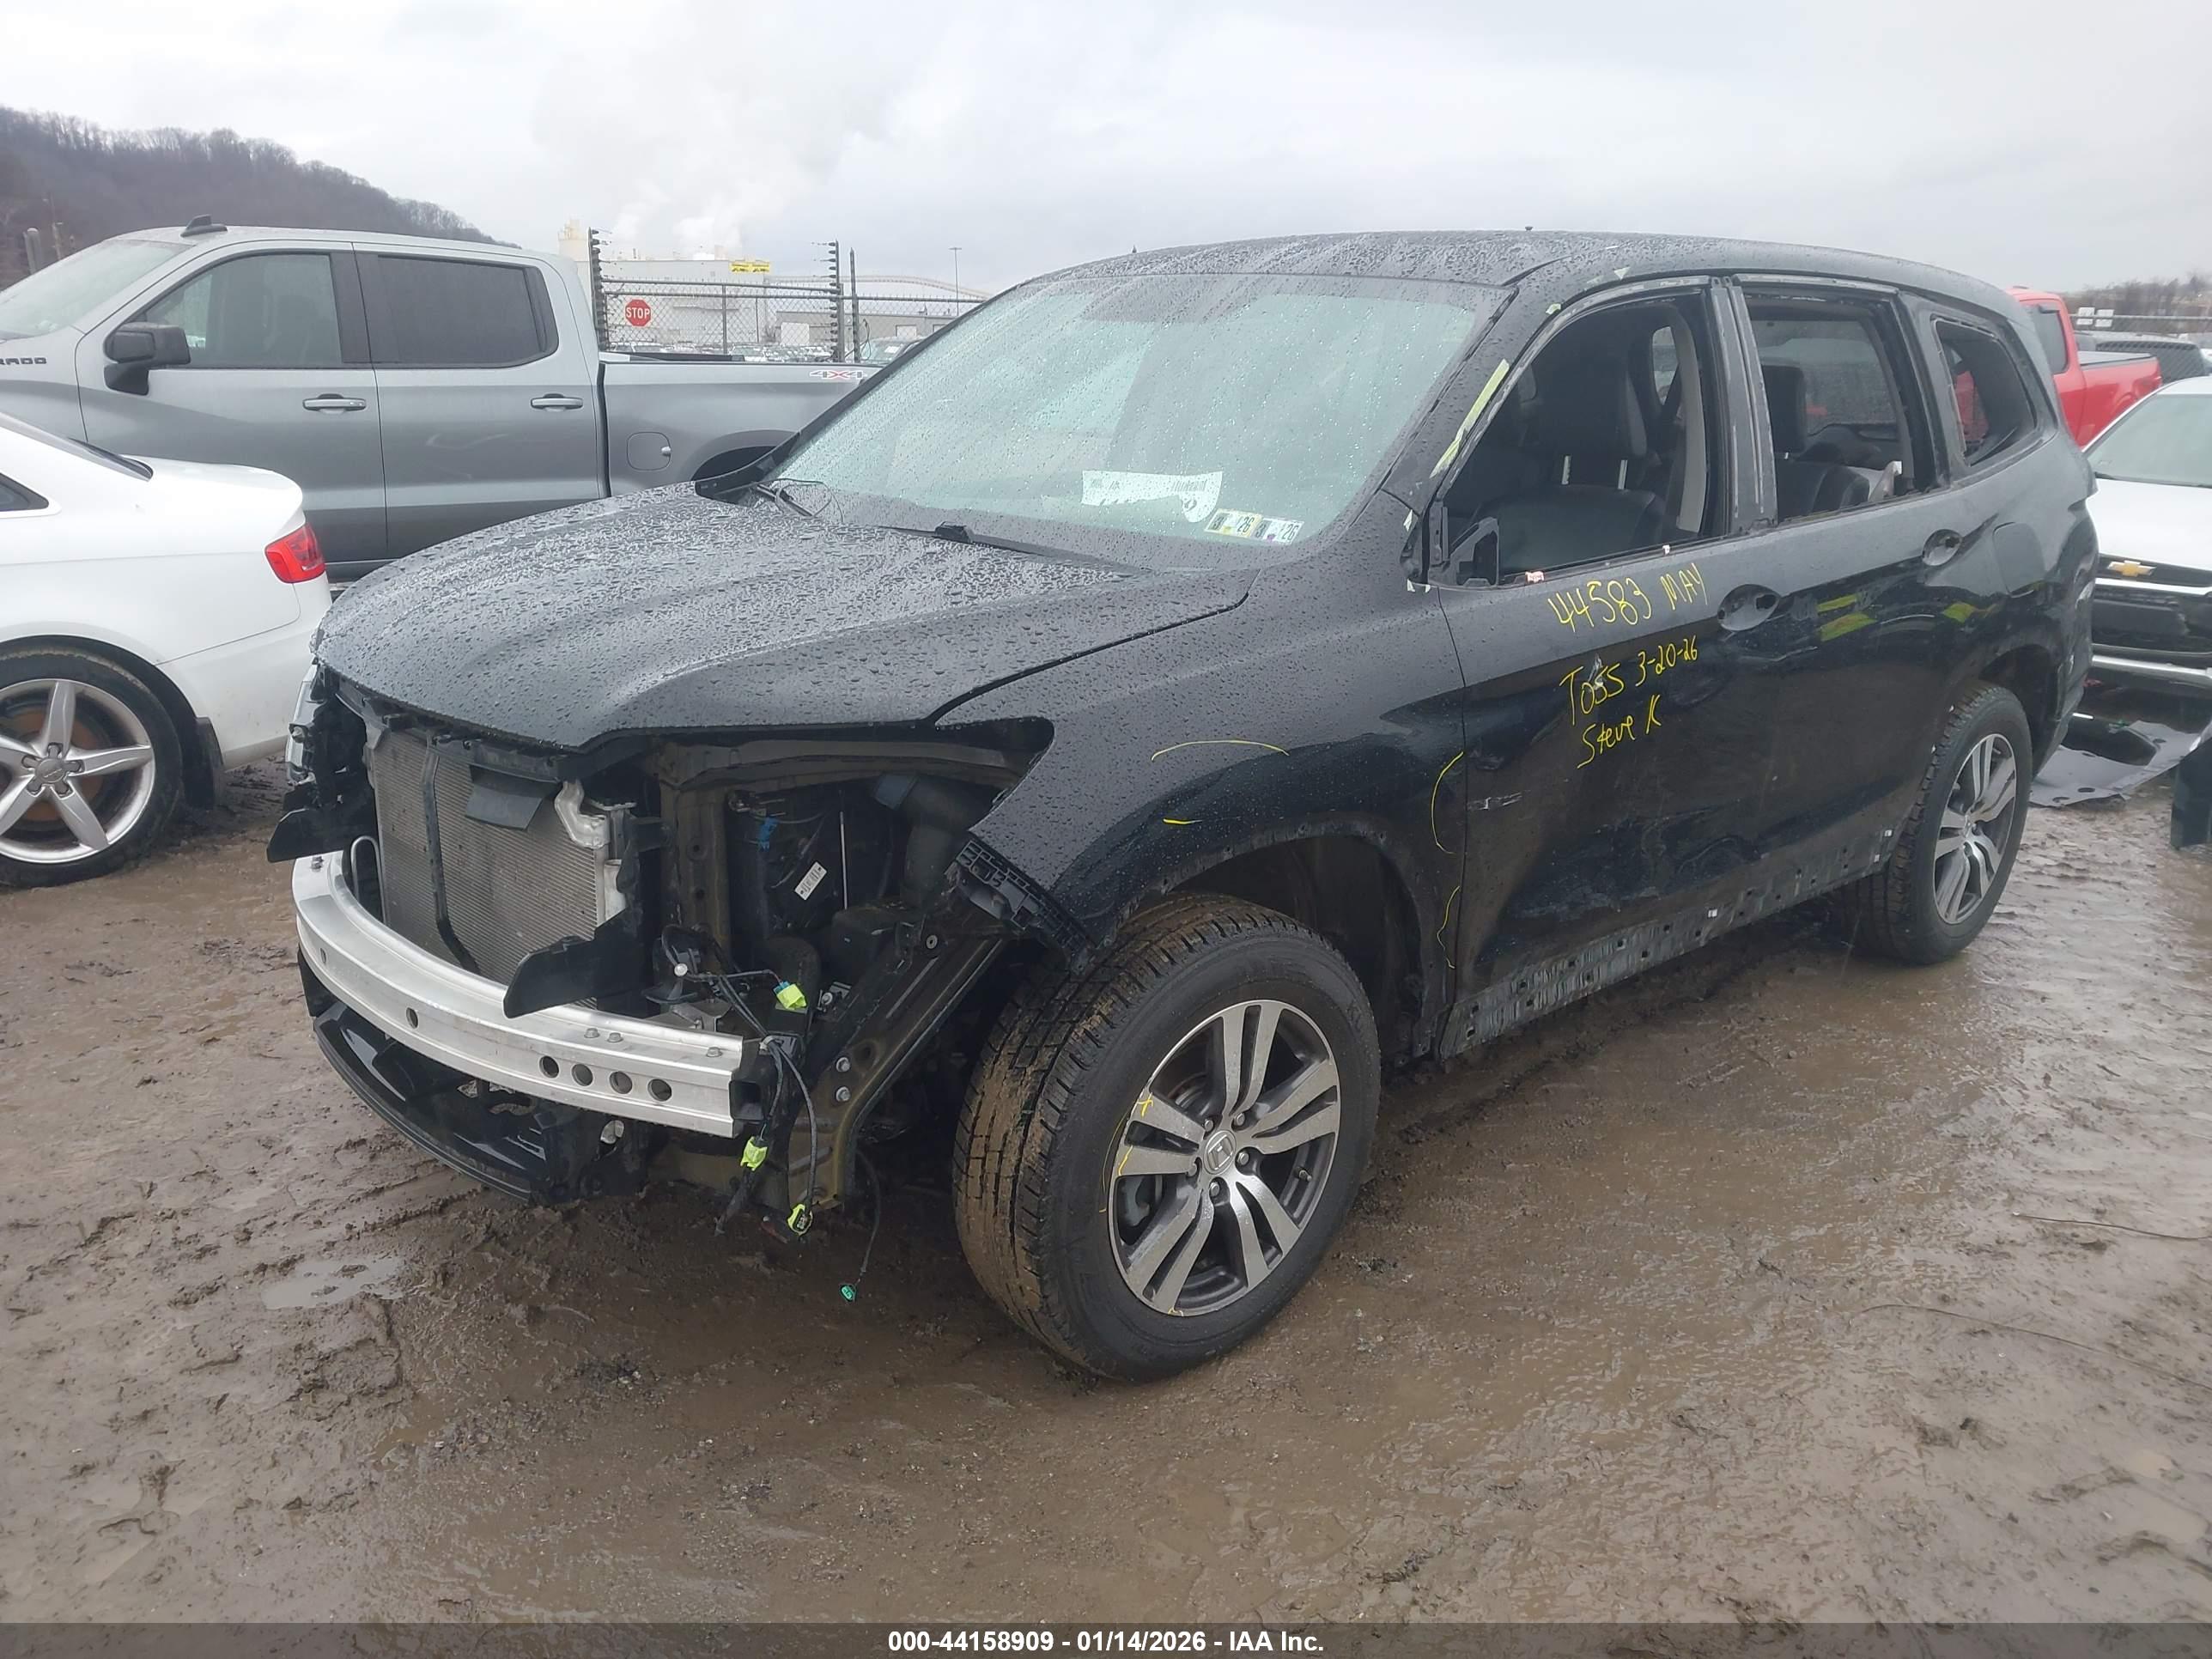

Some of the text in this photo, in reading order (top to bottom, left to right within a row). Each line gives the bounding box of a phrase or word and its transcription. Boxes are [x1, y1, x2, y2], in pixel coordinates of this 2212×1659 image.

[626, 307, 650, 319] STOP
[1547, 562, 1708, 632] 44583 MAY
[1634, 635, 1698, 688] 3-20-26
[1577, 694, 1662, 769] Steve K
